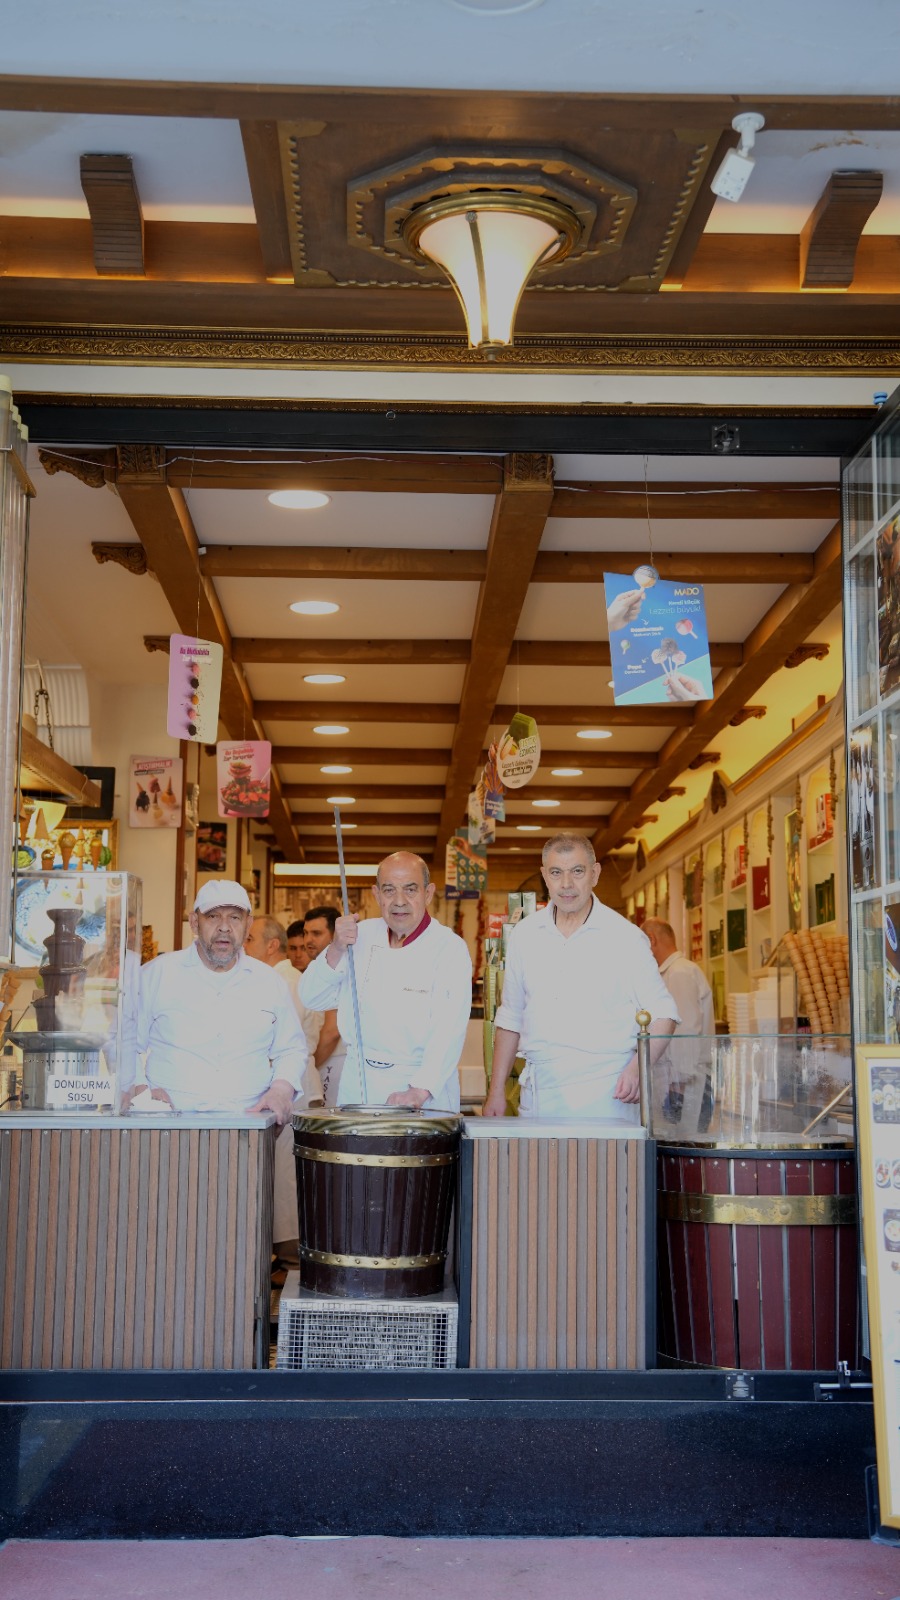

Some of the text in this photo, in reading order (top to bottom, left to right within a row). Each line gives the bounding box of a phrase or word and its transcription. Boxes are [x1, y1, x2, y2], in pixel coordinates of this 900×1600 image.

[674, 587, 700, 597] MADO
[54, 1079, 111, 1090] DONDURMA
[67, 1092, 94, 1103] SOSU
